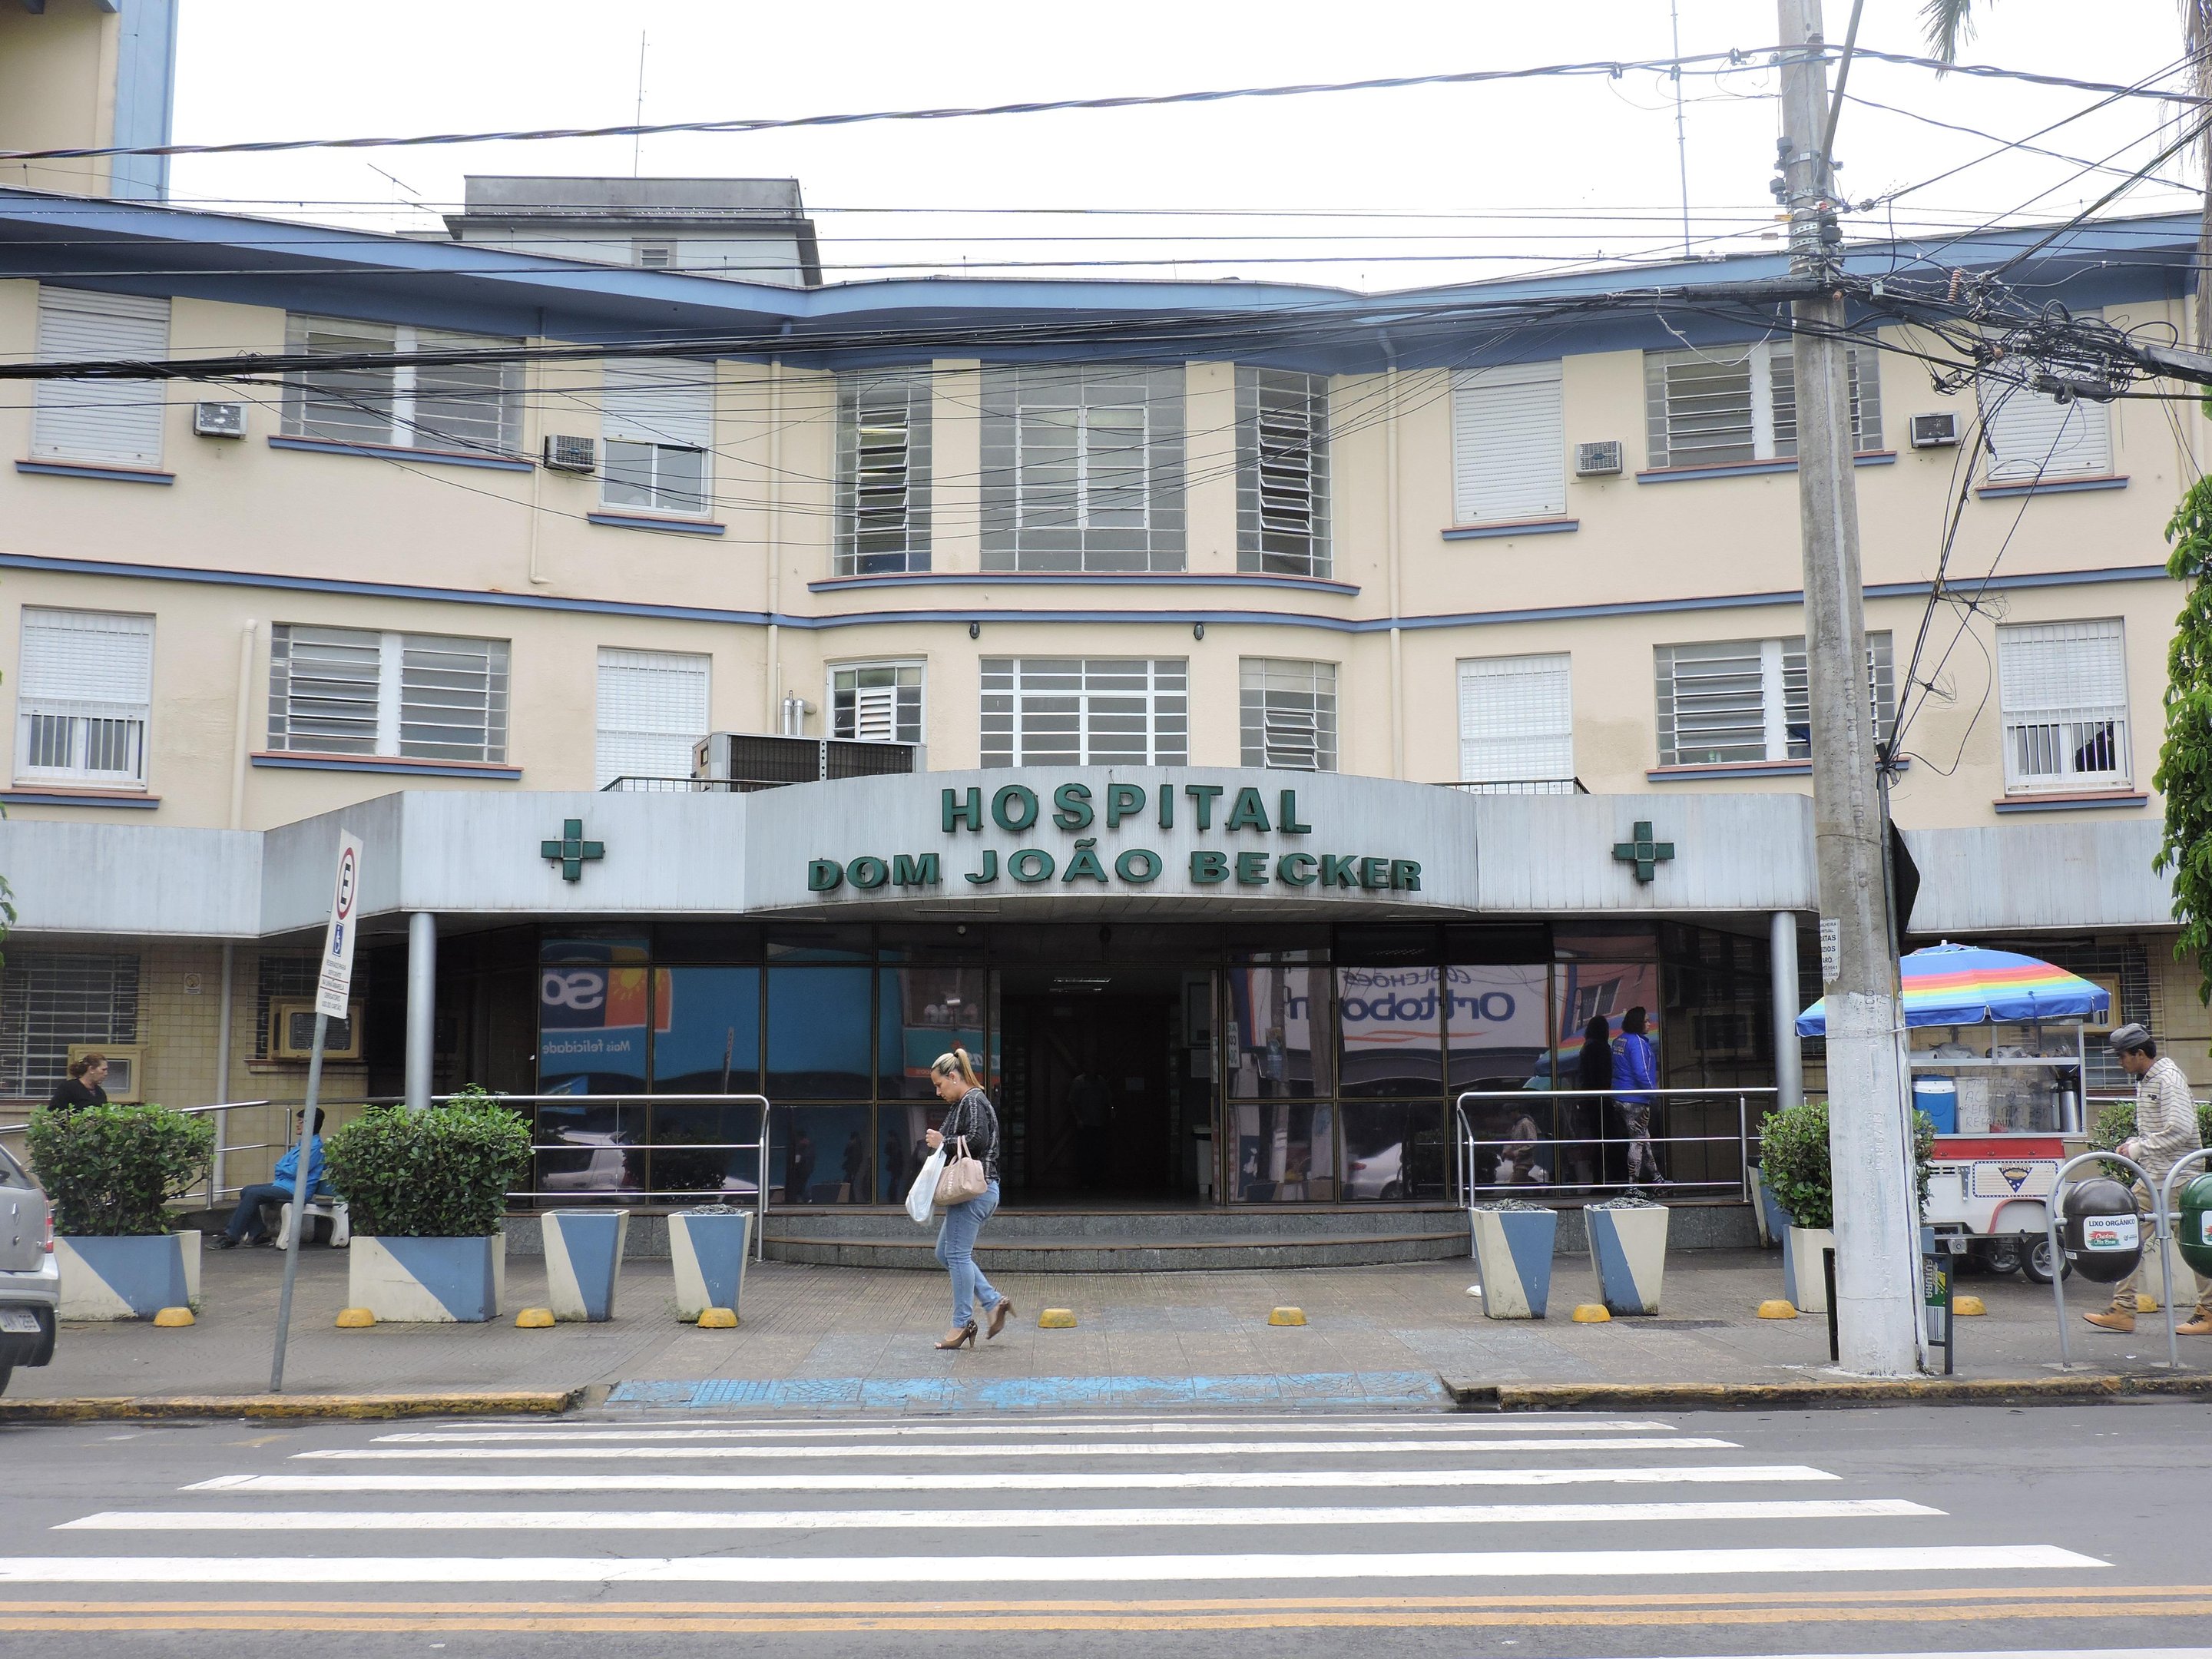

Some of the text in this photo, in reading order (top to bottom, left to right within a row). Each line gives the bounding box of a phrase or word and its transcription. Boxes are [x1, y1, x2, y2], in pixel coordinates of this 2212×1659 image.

[942, 783, 1312, 834] HOSPITAL
[341, 863, 351, 905] E
[808, 837, 1422, 891] DOM JOÃO BECKER
[1925, 1259, 1933, 1299] FUTURA
